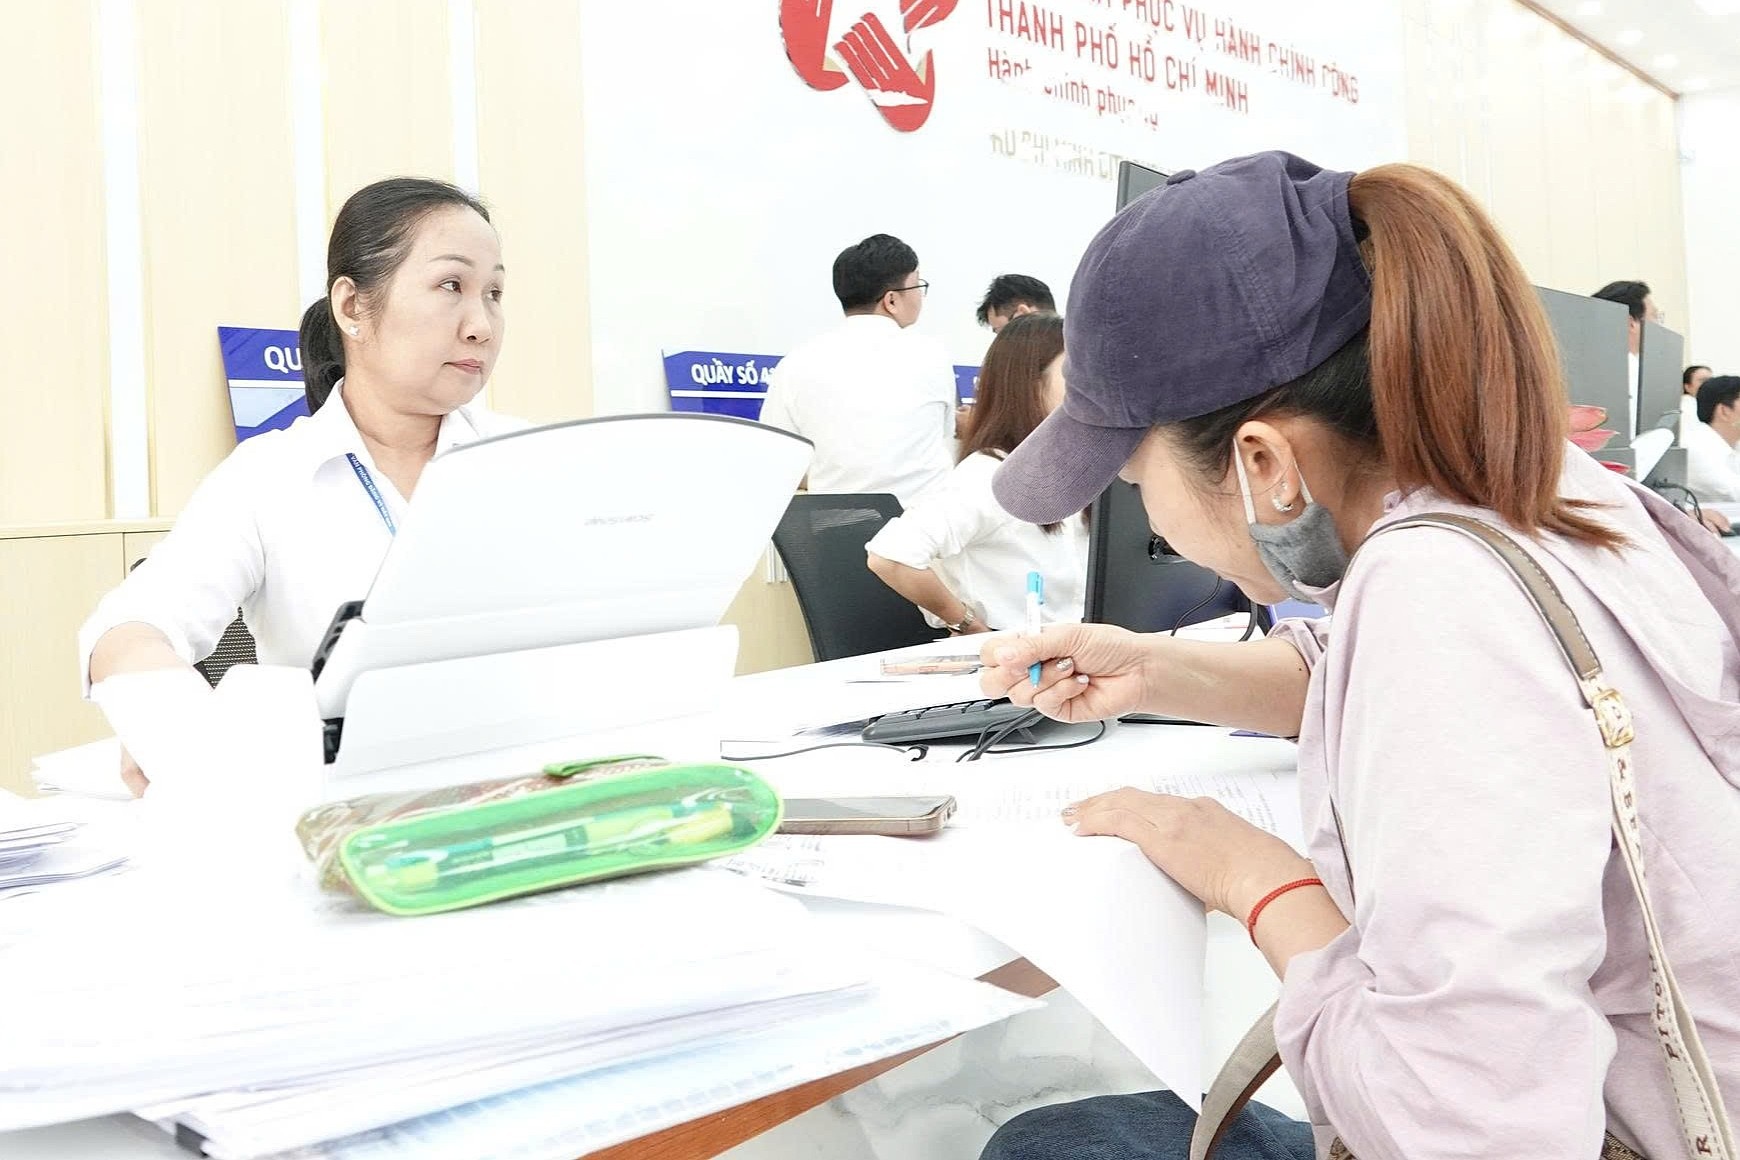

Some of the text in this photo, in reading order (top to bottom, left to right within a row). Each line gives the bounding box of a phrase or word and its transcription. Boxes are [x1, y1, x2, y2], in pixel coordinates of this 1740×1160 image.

[1205, 69, 1249, 114] MINH
[691, 358, 734, 386] QUẦY
[736, 360, 759, 385] SỐ
